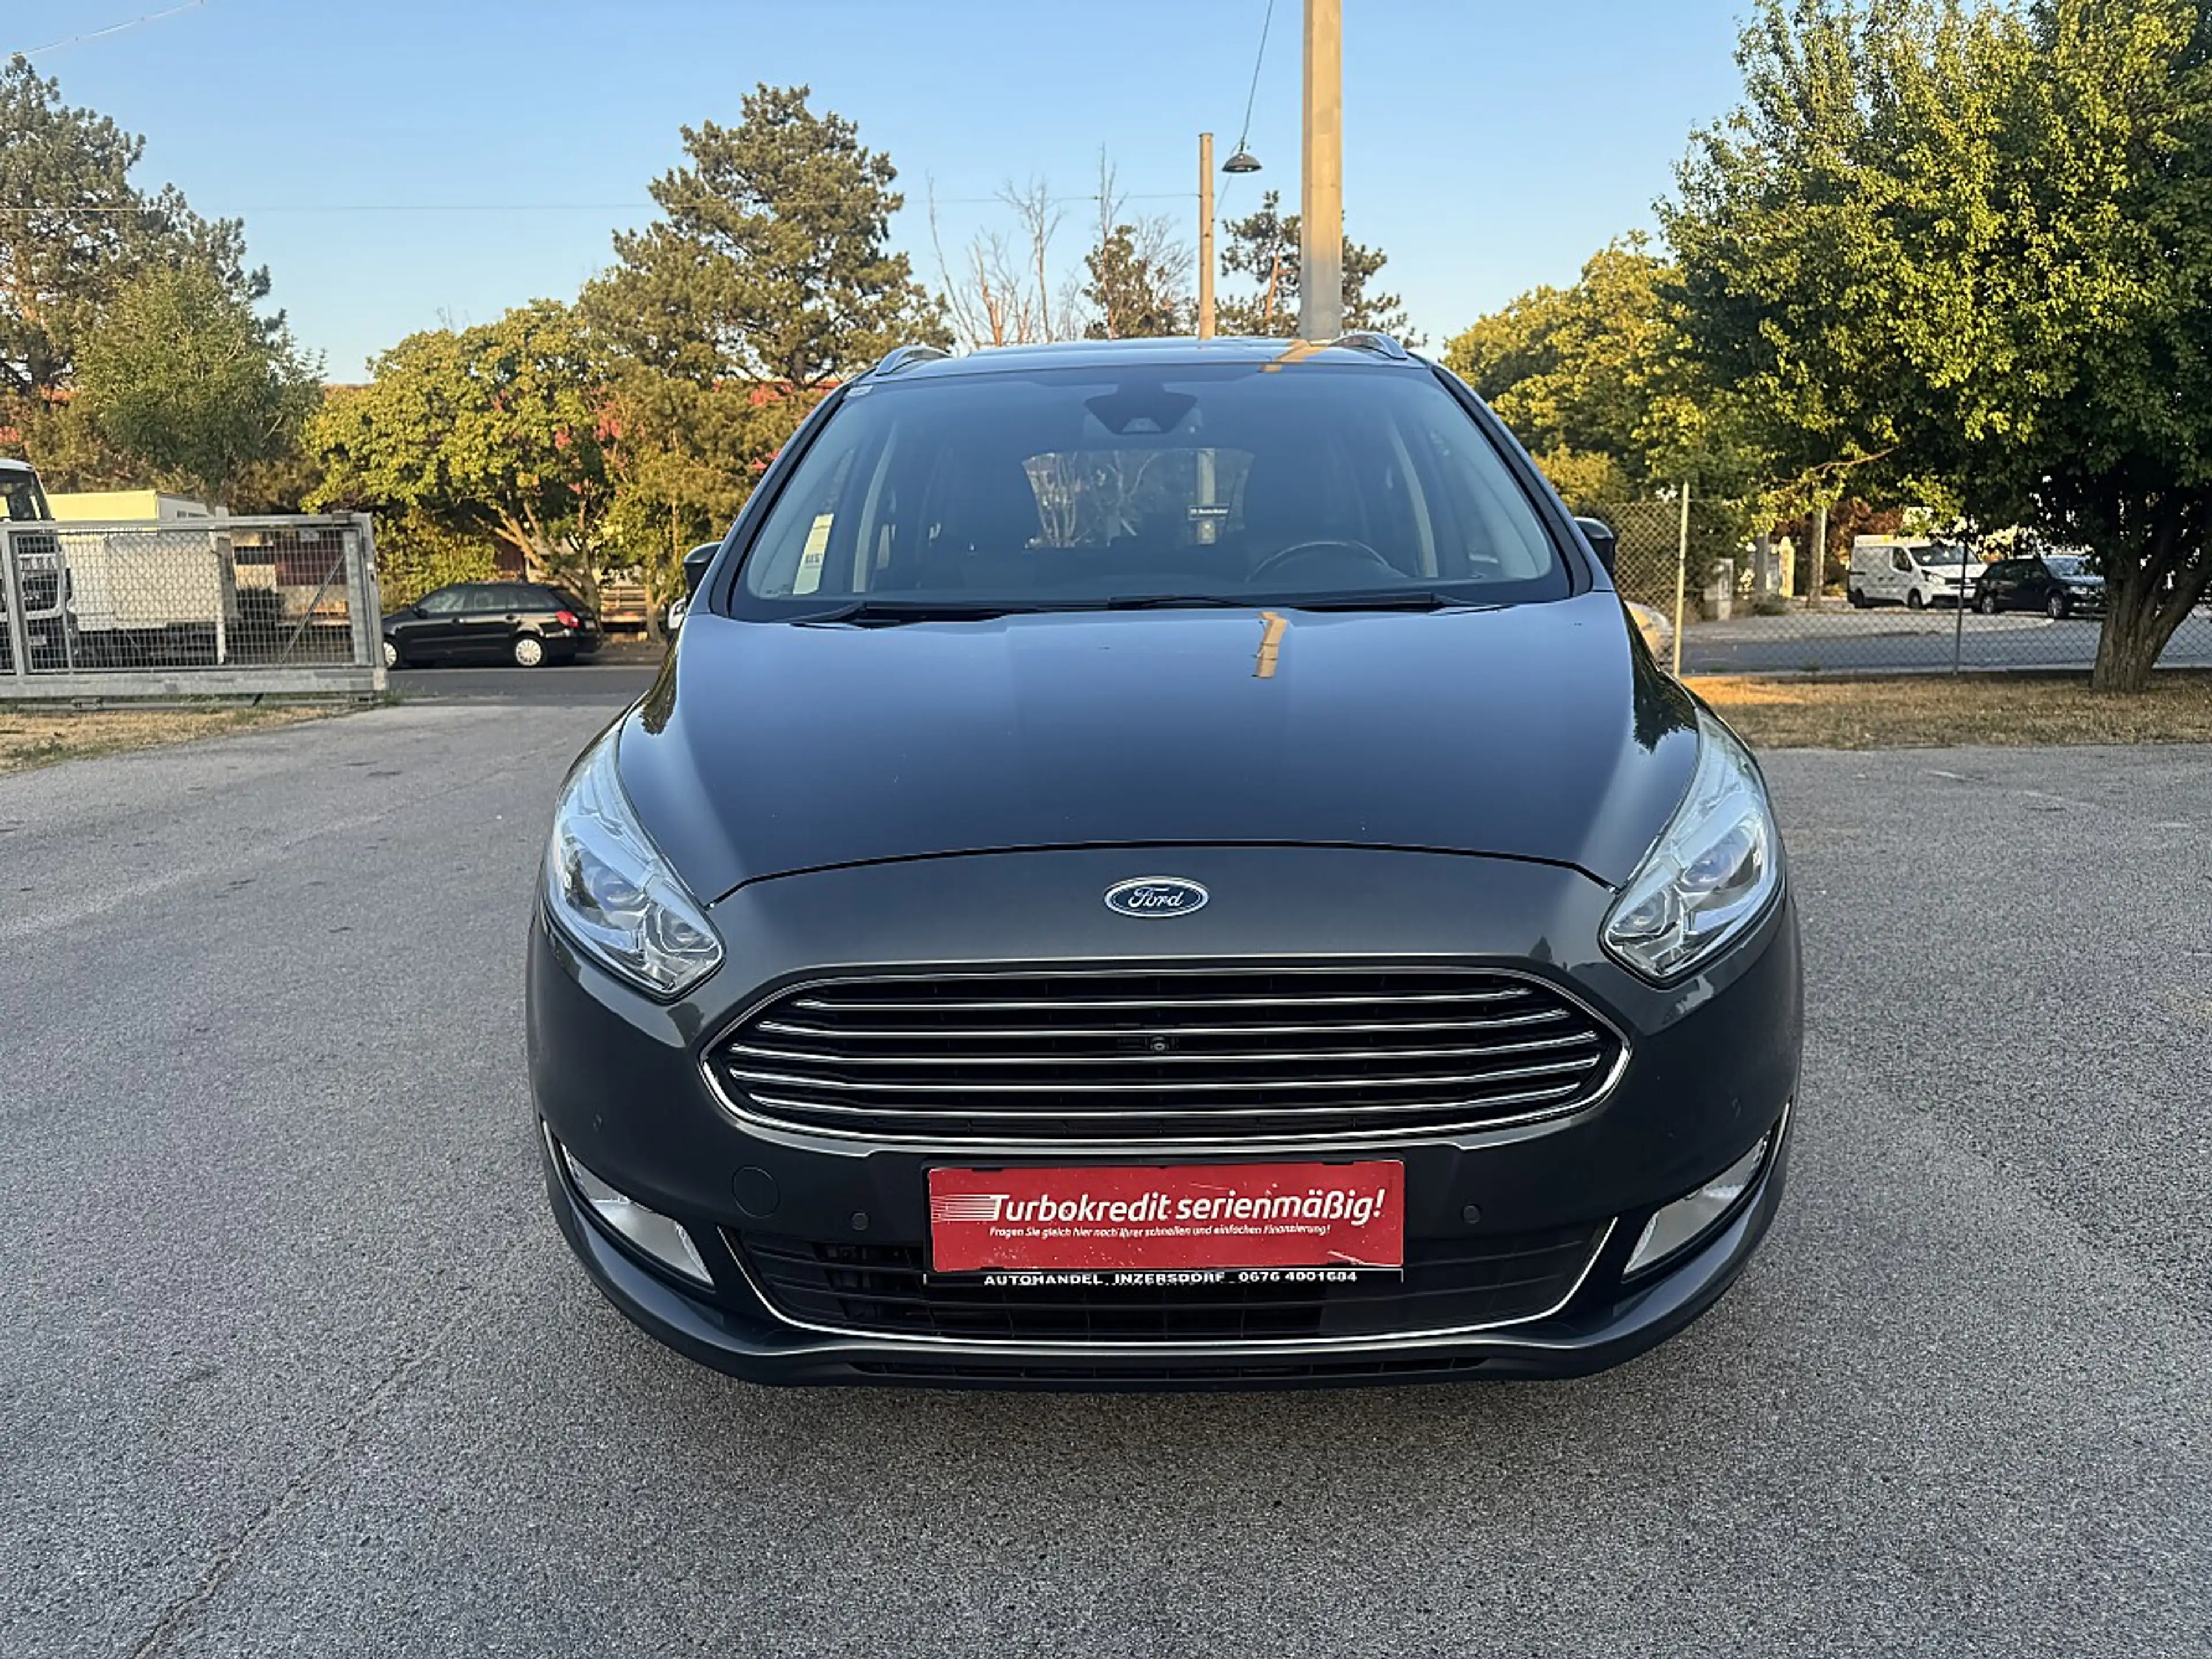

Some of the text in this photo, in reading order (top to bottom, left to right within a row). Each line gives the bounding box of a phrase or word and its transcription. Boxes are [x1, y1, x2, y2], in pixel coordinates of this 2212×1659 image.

[1128, 887, 1184, 908] Ford
[991, 1188, 1385, 1226] Turbokredit serienmäßig!
[989, 1226, 1024, 1239] Fragen
[1025, 1226, 1040, 1237] Sie
[1041, 1226, 1071, 1240] gleich
[1073, 1226, 1093, 1237] hier
[1145, 1225, 1191, 1237] schnellen
[1192, 1225, 1212, 1236] und
[1213, 1224, 1262, 1235] einfachen
[1263, 1222, 1331, 1236] Finanzierung!
[1238, 1271, 1281, 1283] 0676
